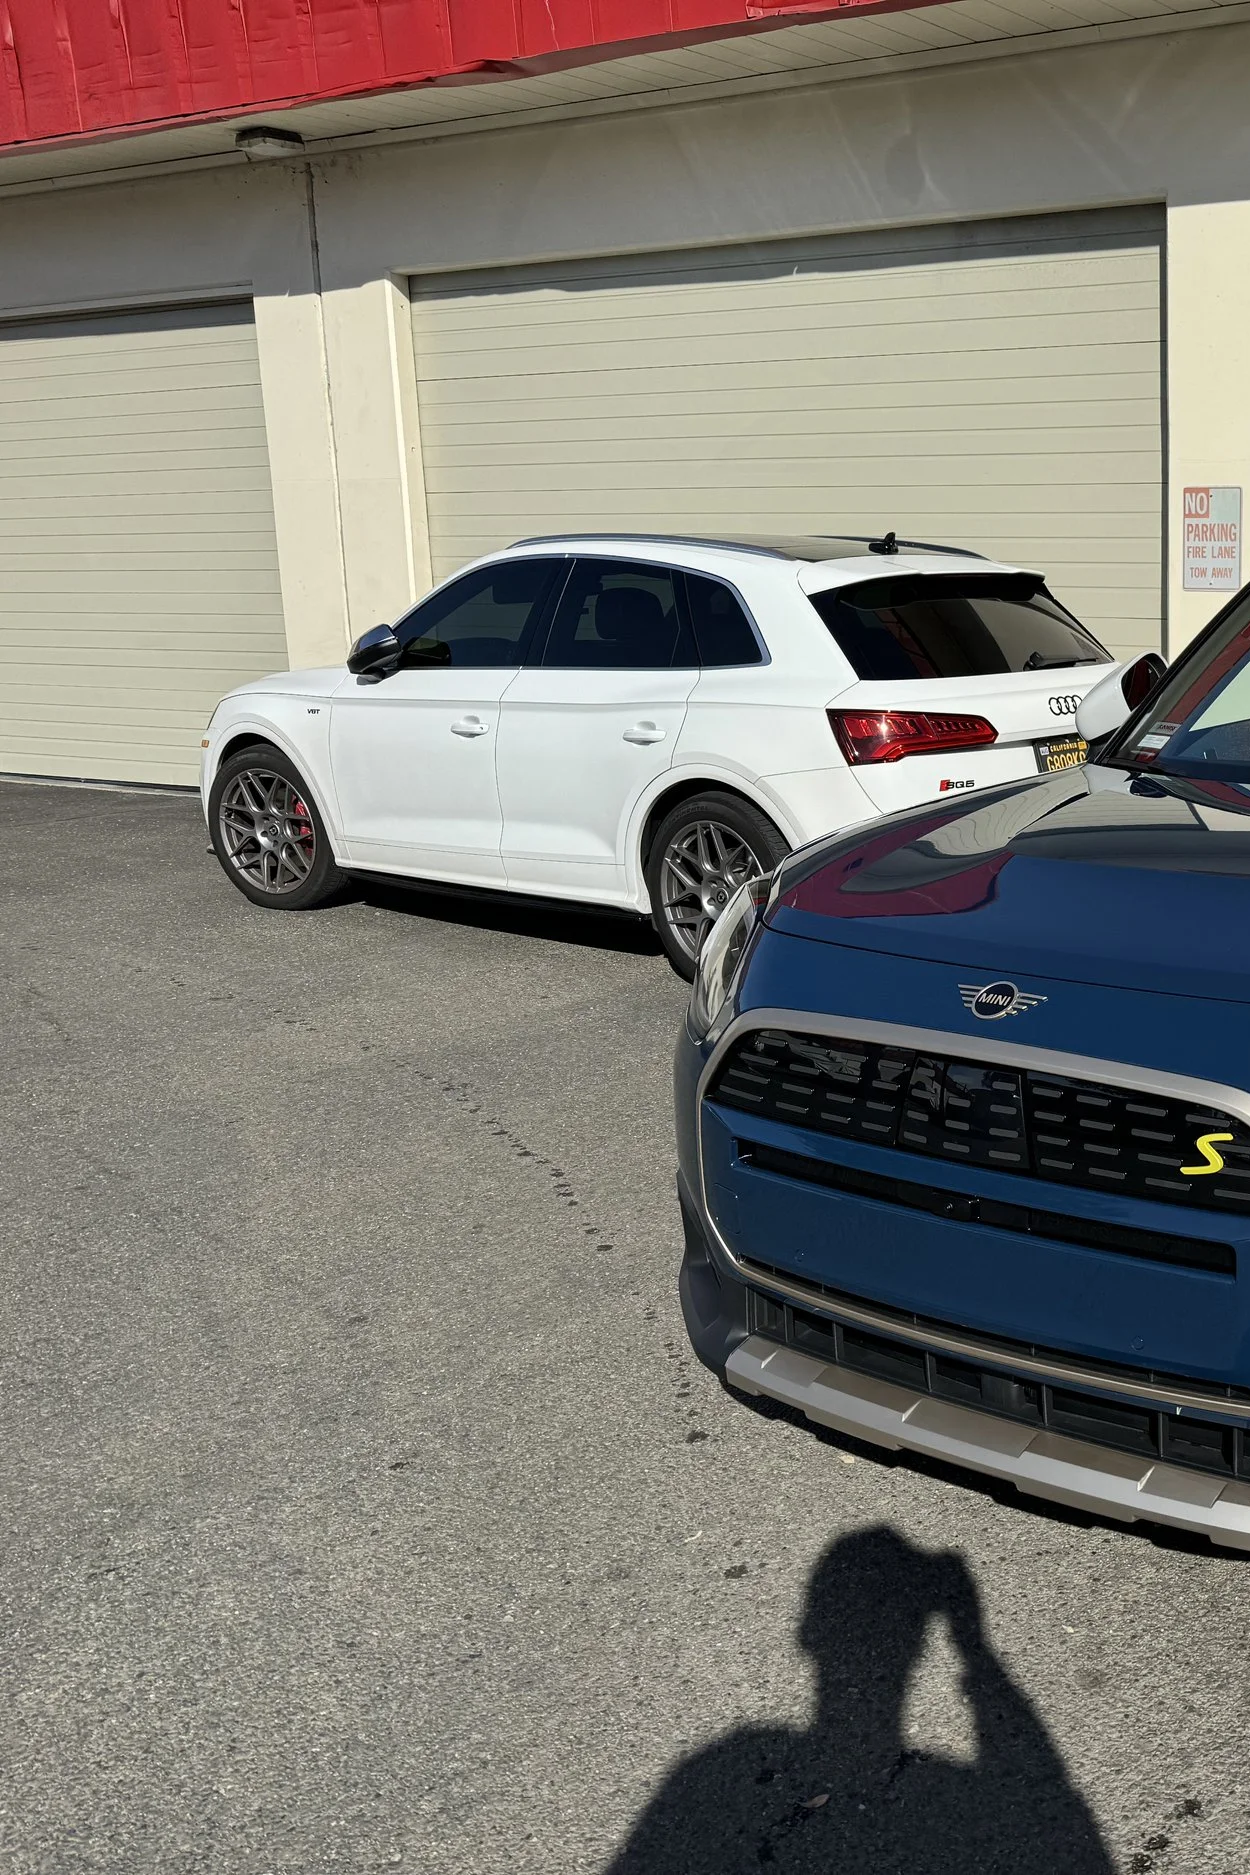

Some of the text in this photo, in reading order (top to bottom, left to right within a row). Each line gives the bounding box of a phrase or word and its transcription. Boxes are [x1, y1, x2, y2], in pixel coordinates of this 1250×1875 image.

[1185, 492, 1208, 515] NO
[1186, 523, 1237, 542] PARKING
[1187, 546, 1236, 559] FIRE LANE
[1190, 567, 1233, 578] TOW AWAY
[978, 992, 1011, 1006] MINI
[1180, 1133, 1234, 1175] S
